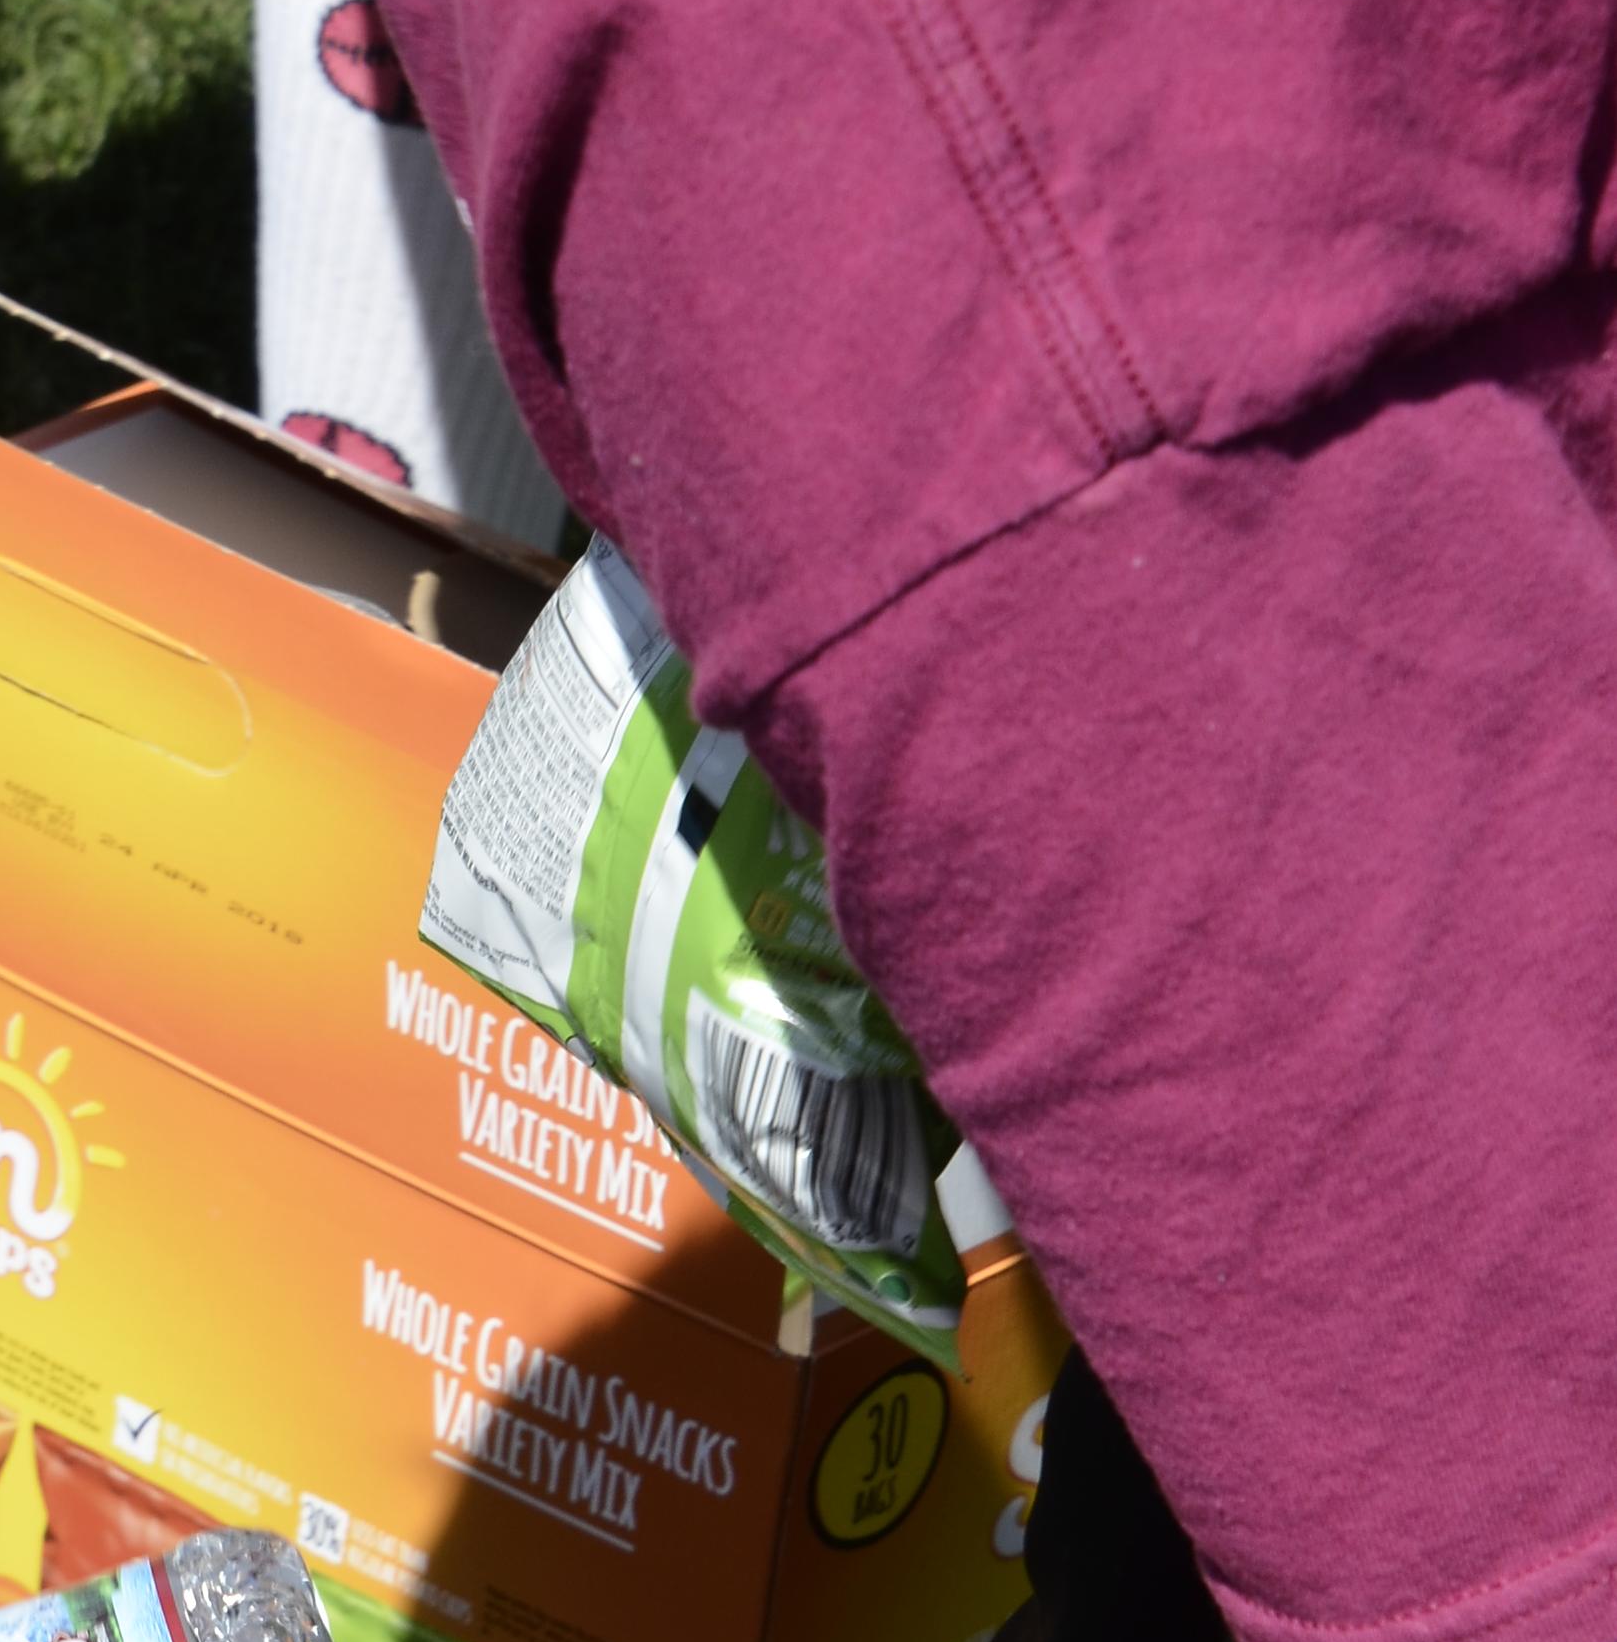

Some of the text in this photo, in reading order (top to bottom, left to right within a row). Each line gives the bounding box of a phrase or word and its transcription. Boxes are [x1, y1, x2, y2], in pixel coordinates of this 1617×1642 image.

[386, 960, 497, 1074] WHOLE
[500, 1017, 620, 1130] GRAIN
[459, 1071, 595, 1195] VARIETY
[596, 1139, 668, 1232] MIX
[363, 1259, 738, 1497] WHOLE GRAIN SNACKS
[433, 1370, 642, 1532] VARIETY MIX
[864, 1393, 909, 1482] 30
[852, 1475, 897, 1525] BAGS
